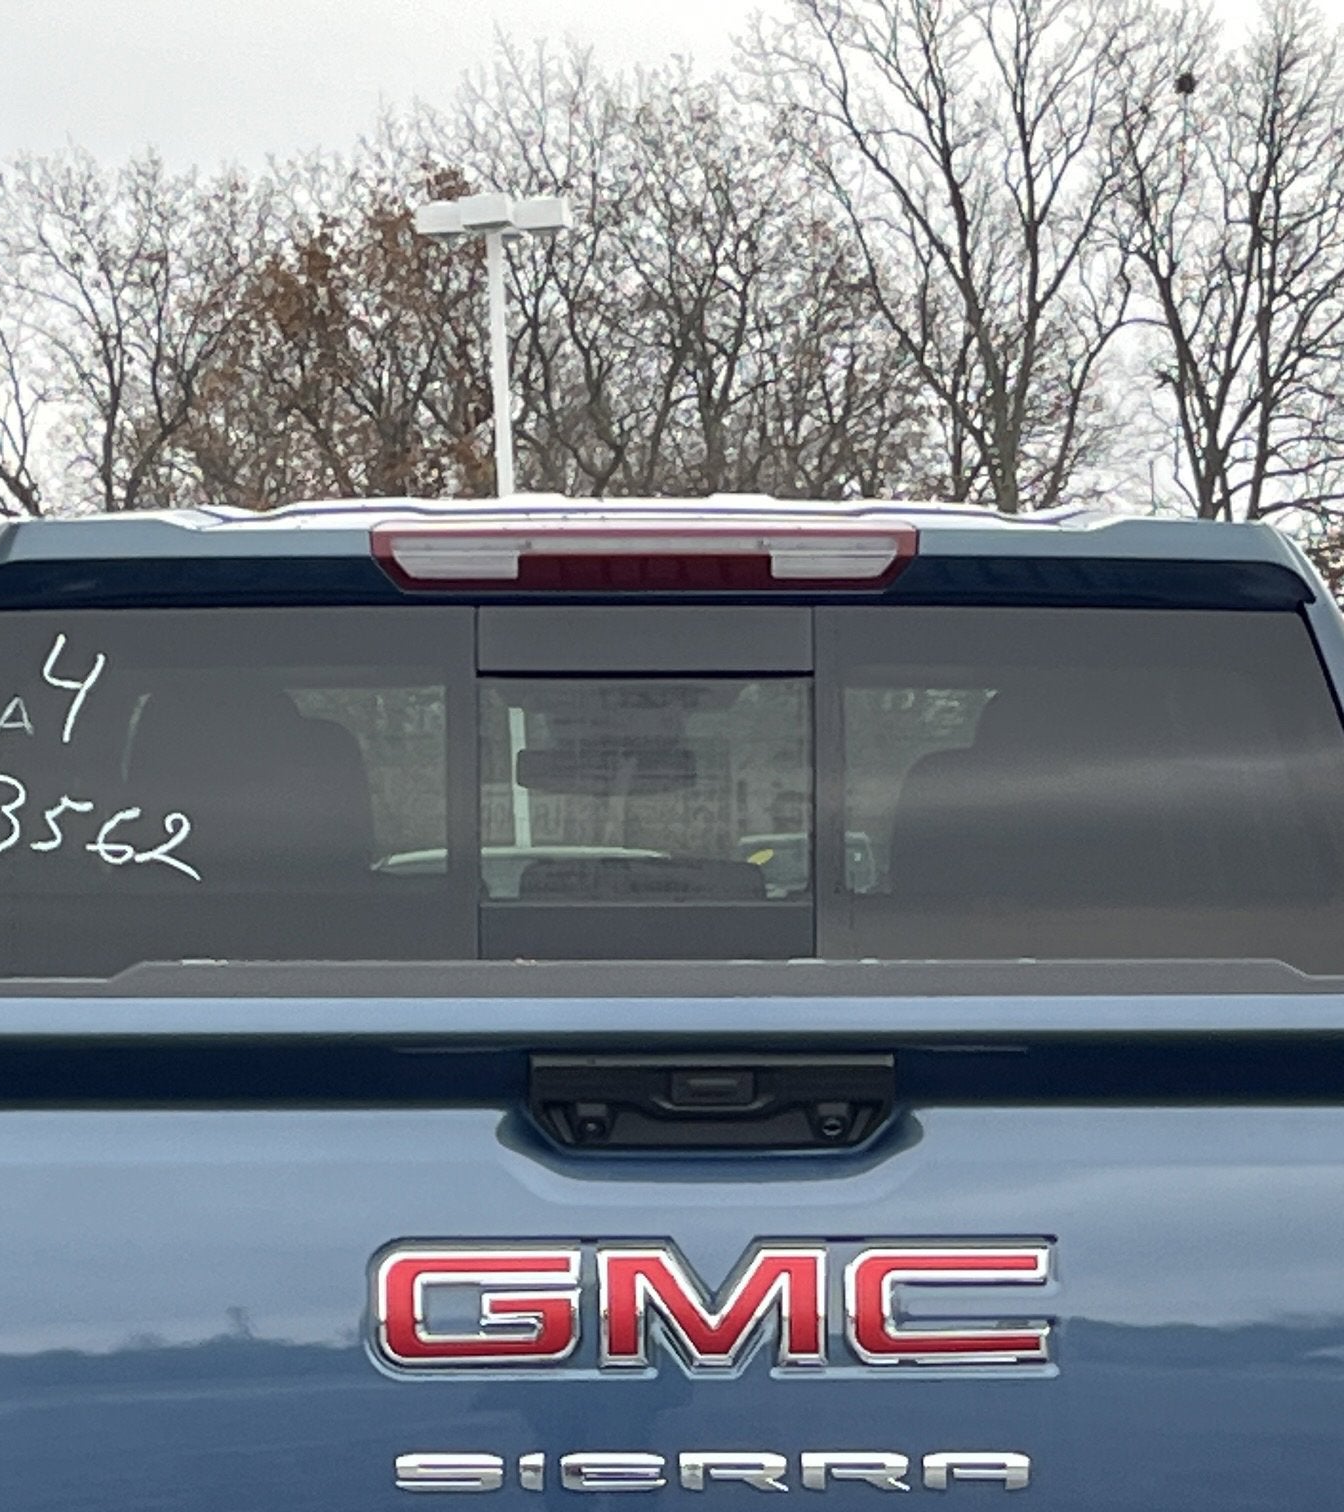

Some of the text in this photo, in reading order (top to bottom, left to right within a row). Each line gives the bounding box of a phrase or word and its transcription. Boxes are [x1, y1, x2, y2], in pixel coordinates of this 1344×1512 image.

[42, 633, 105, 743] 4
[376, 1246, 1050, 1368] GMC
[394, 1452, 1032, 1492] SIERRA
